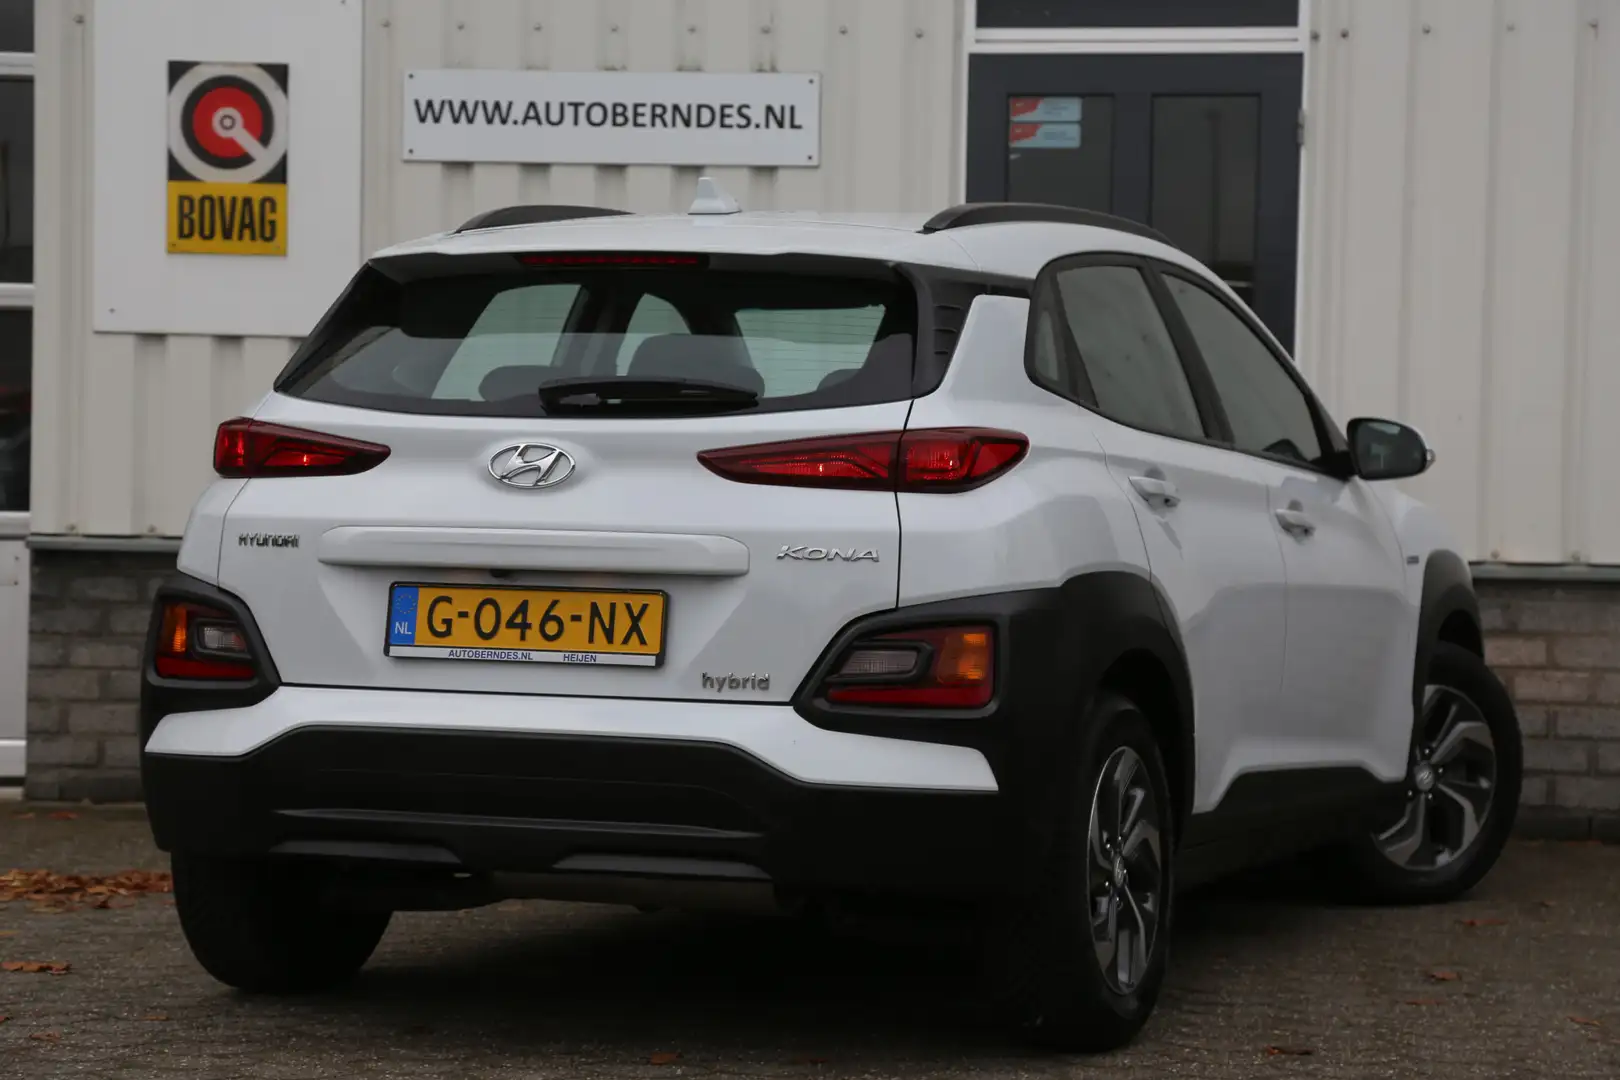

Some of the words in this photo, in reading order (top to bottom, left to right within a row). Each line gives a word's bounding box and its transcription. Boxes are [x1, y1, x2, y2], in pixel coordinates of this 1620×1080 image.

[414, 98, 803, 130] WWW.AUTOBERNDES.NL
[177, 194, 278, 243] BOVAG
[238, 532, 300, 548] HYUNDAI
[776, 545, 880, 563] KONA
[394, 621, 412, 636] NL
[427, 595, 649, 646] G-046-NX
[448, 649, 534, 662] AUTOBERNDES.NL
[563, 653, 597, 664] HEIJEN
[701, 672, 771, 693] hybrid
